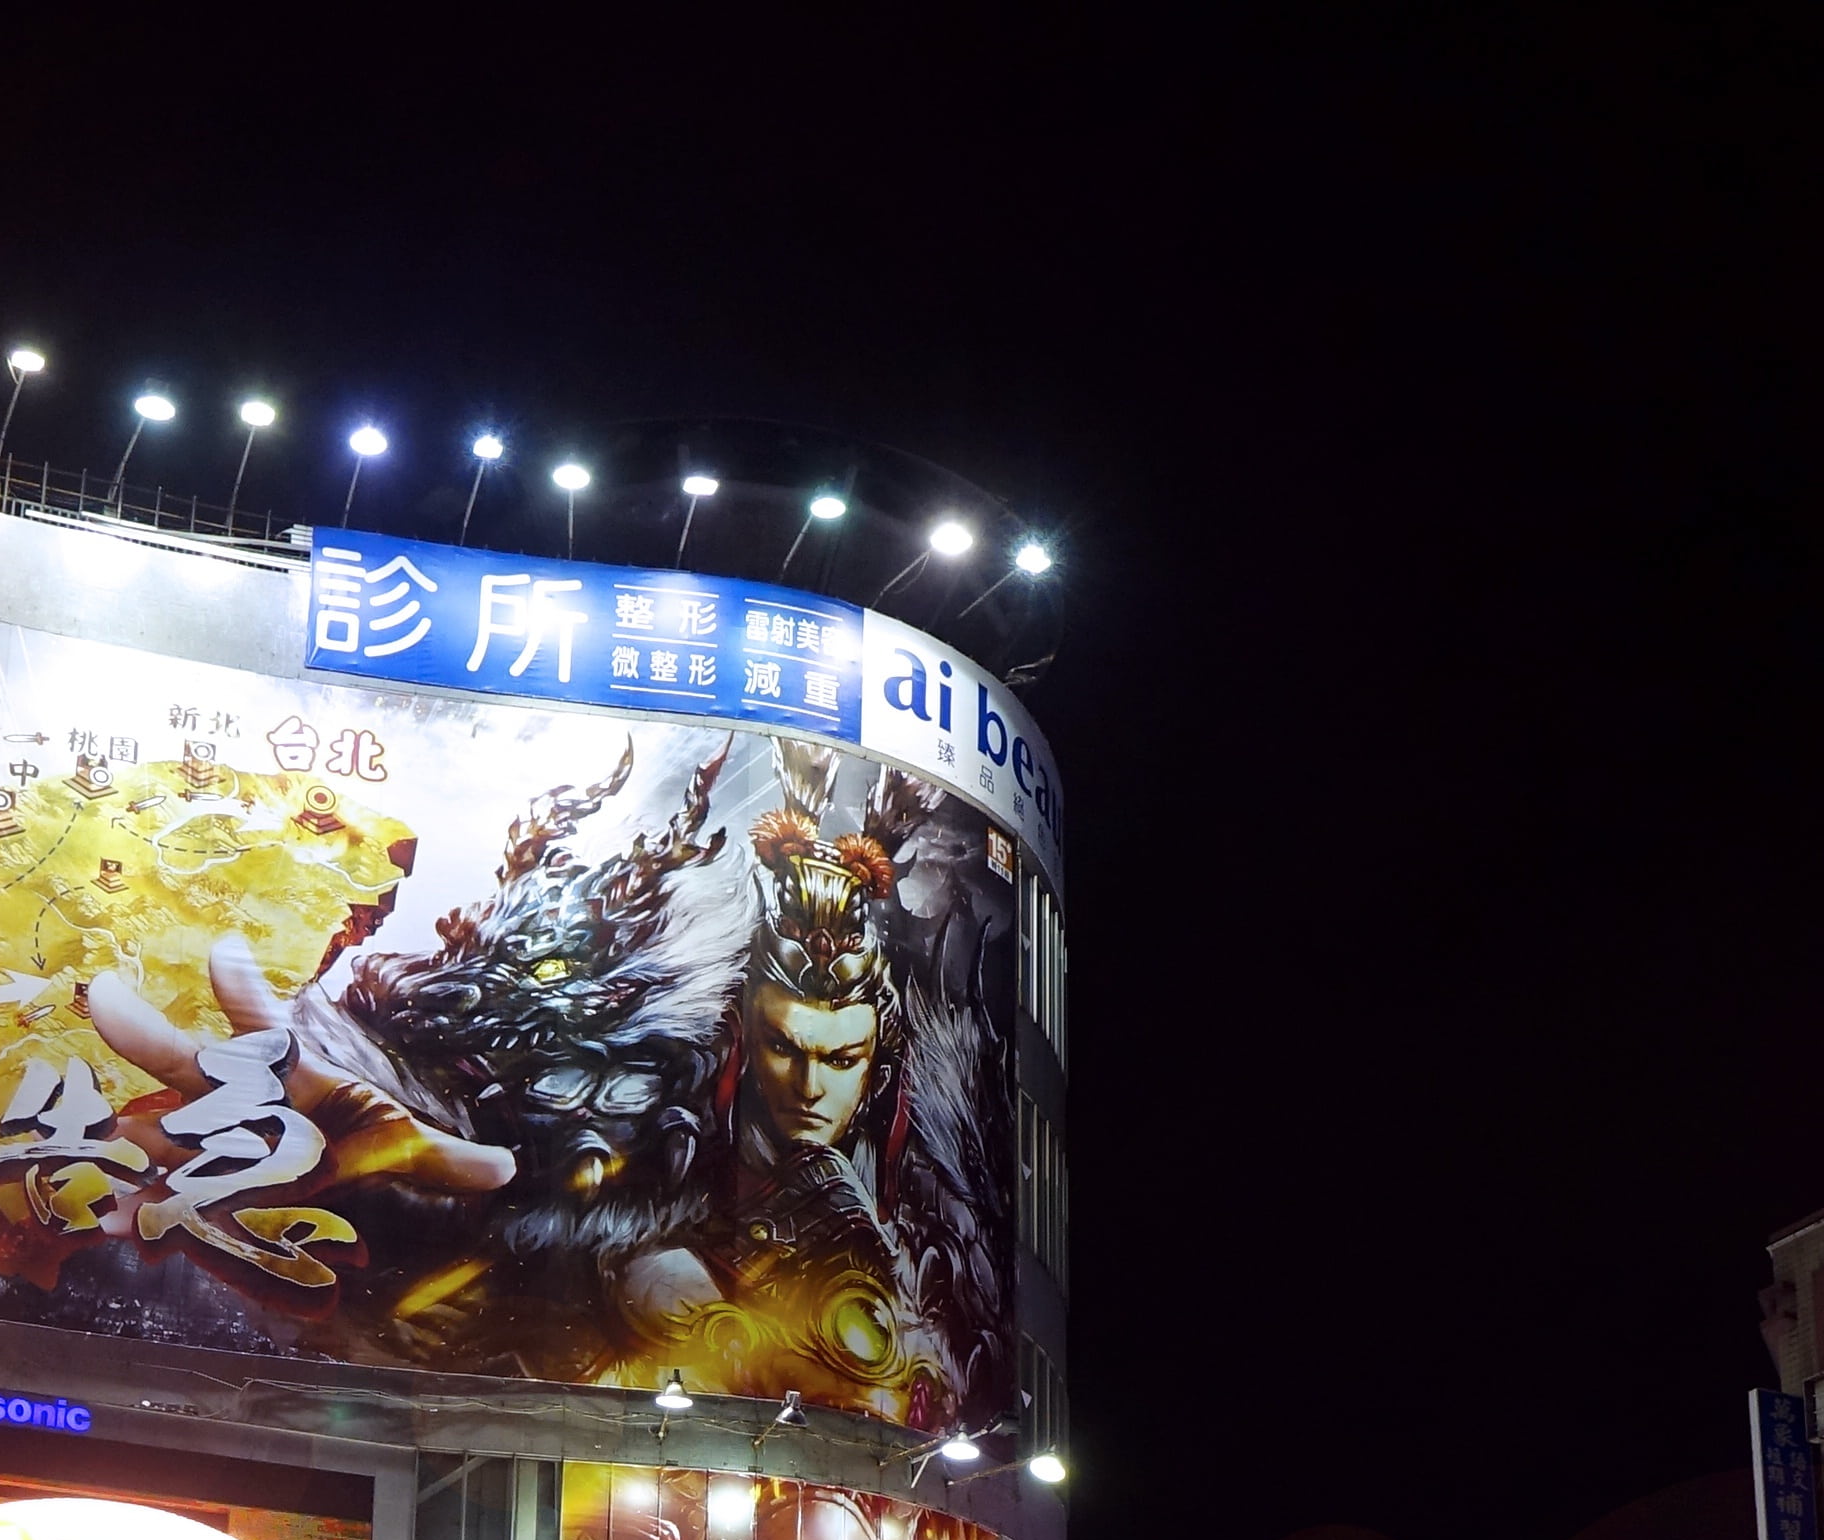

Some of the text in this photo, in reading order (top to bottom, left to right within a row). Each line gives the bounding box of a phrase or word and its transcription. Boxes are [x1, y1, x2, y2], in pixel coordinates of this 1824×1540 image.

[314, 546, 589, 684] 診所
[614, 592, 720, 637] 整形
[611, 646, 842, 711] 微整形 減重
[883, 648, 952, 733] ai
[67, 727, 140, 766] 桃園
[168, 703, 242, 741] 新北
[266, 714, 389, 783] 台北
